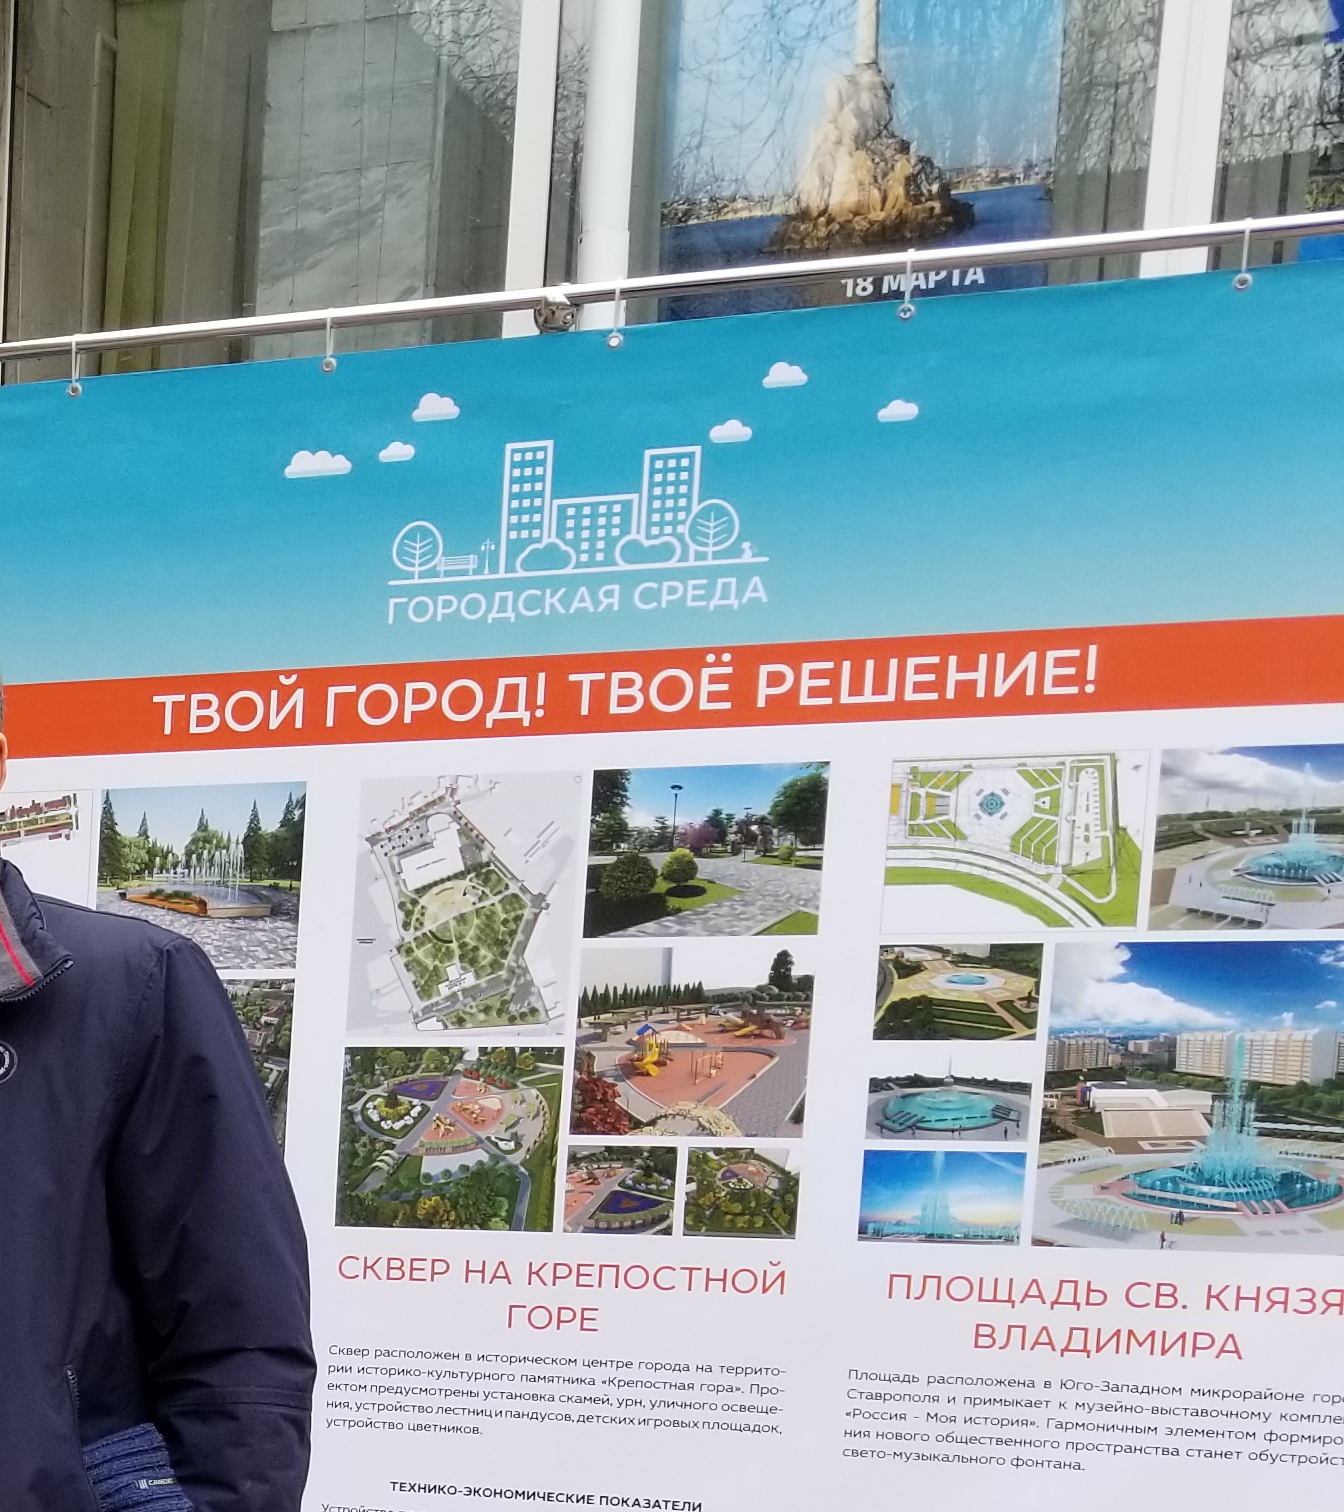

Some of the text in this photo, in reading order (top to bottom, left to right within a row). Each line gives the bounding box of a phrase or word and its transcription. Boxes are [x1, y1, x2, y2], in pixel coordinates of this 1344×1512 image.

[841, 277, 874, 297] 18
[388, 575, 768, 624] ГОРОДСКАЯ СРЕДА
[152, 644, 1098, 735] ТВОЙ ГОРОД! ТВОЁ РЕШЕНИЕ!
[337, 1255, 785, 1295] СКВЕР НА КРЕПОСТНОЙ
[887, 1273, 1344, 1315] ПЛОЩАДЬ СВ. КНЯЗЯ
[507, 1304, 599, 1331] ГОРЕ
[973, 1322, 1243, 1360] ВЛАДИМИРА
[328, 1344, 786, 1377] Сквер расположен в историческом центре города на террито-
[327, 1364, 785, 1397] рии историко-культурного памятника «Крепостная гора». Про-
[848, 1368, 919, 1384] Площадь
[926, 1375, 1036, 1388] расположена
[1043, 1380, 1051, 1388] в
[1059, 1378, 1182, 1395] Юго-Западном
[1190, 1387, 1304, 1402] микрорайоне
[326, 1382, 783, 1415] ектом предусмотрены установка скамей, урн, уличного освеще-
[846, 1388, 1344, 1424] Ставрополя и примыкает к музейно-выставочному компле
[325, 1400, 782, 1435] ния, устройство лестниц и пандусов, детских игровых площадок,
[325, 1416, 482, 1434] устройство цветников.
[845, 1407, 907, 1421] «Россия
[925, 1411, 957, 1424] Моя
[963, 1415, 1039, 1428] история».
[1046, 1417, 1158, 1435] Гармоничным
[1164, 1426, 1256, 1440] элементом
[842, 1448, 1085, 1470] свето-музыкального фонтана.
[843, 1429, 870, 1438] ния
[875, 1430, 930, 1441] нового
[934, 1430, 1060, 1449] общественного
[1065, 1441, 1180, 1456] пространства
[1185, 1448, 1243, 1459] станет
[389, 1481, 702, 1512] ТЕХНИКО-ЭКОНОМИЧЕСКИЕ ПОКАЗАТЕЛИ
